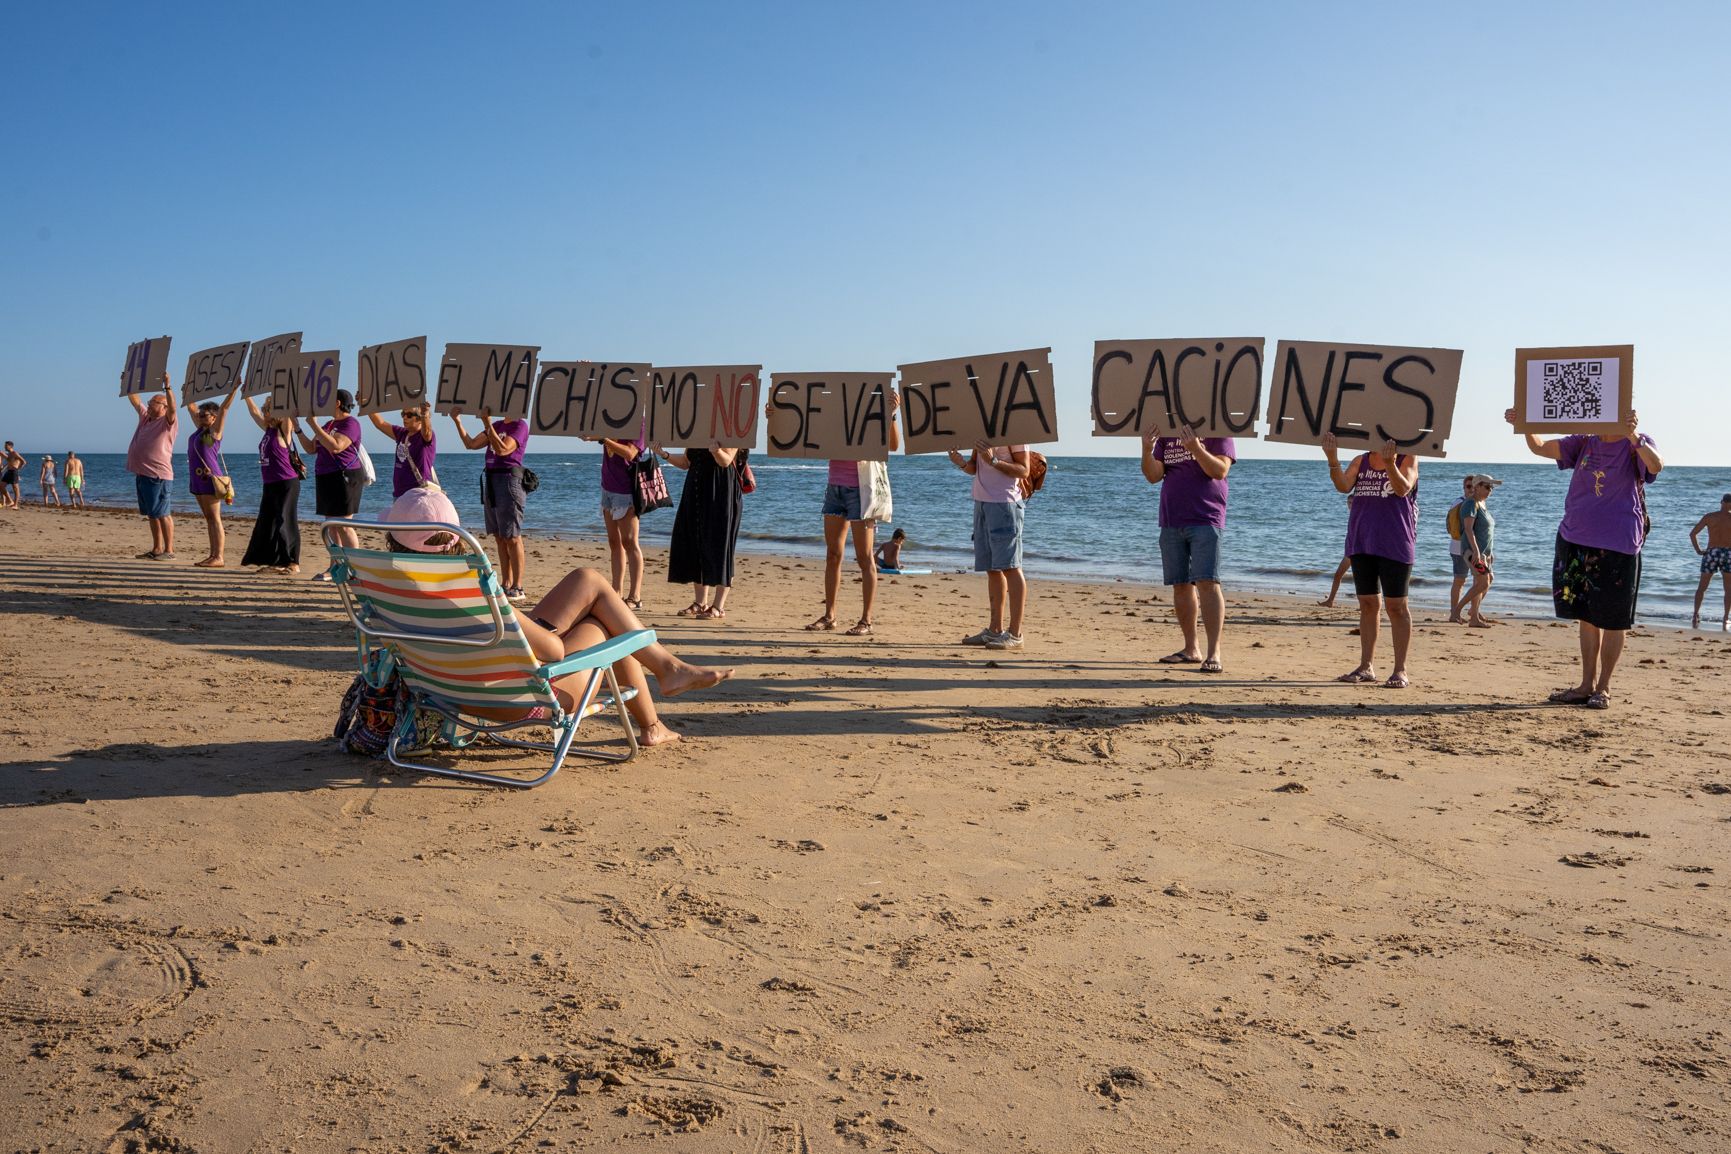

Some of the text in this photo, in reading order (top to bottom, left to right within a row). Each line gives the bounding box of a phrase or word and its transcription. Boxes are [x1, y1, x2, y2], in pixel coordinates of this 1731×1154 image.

[127, 340, 151, 393] 14
[273, 357, 335, 410] EN 16
[360, 343, 424, 408] DÍAS
[437, 348, 532, 413] EL MA
[903, 360, 1052, 439] DE VA
[1275, 346, 1439, 450] NES.
[649, 371, 759, 442] MO NO
[770, 380, 887, 451] SE VA
